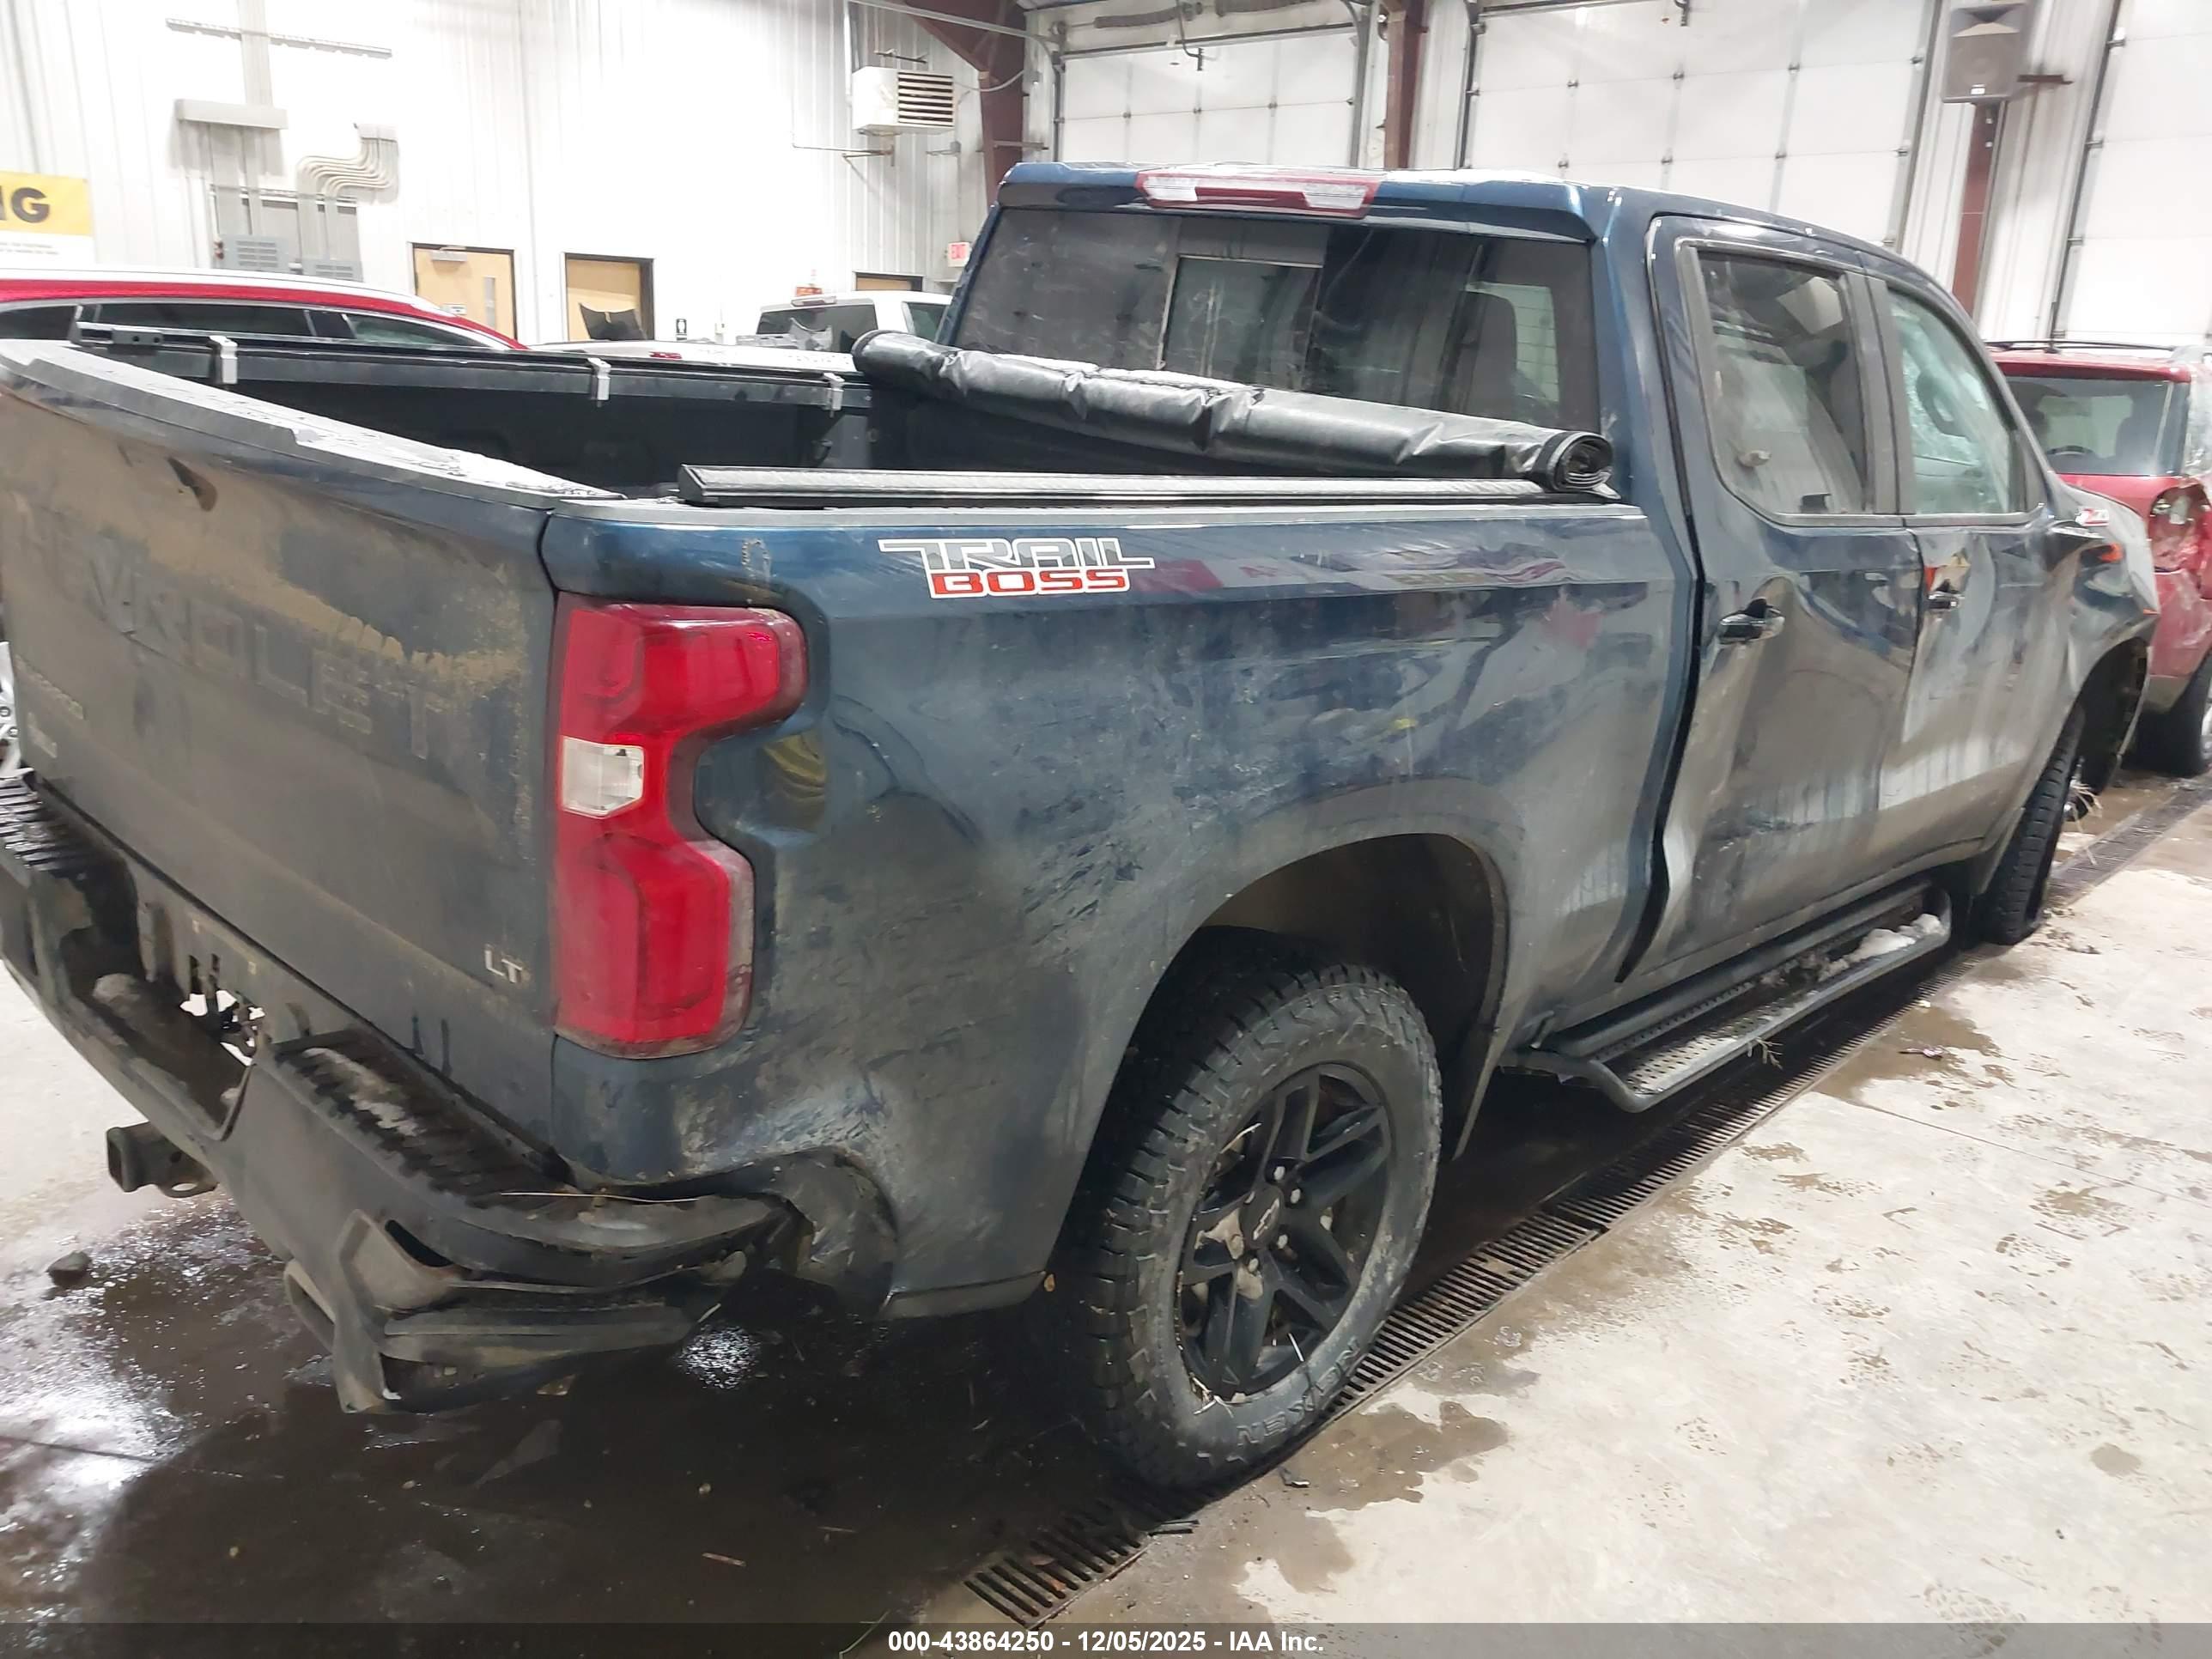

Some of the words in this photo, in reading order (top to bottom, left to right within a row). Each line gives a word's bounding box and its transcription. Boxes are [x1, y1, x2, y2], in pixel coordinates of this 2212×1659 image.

[0, 185, 51, 224] G
[878, 538, 1155, 569] TRAIL
[929, 568, 1129, 599] BOSS
[484, 943, 523, 983] LT
